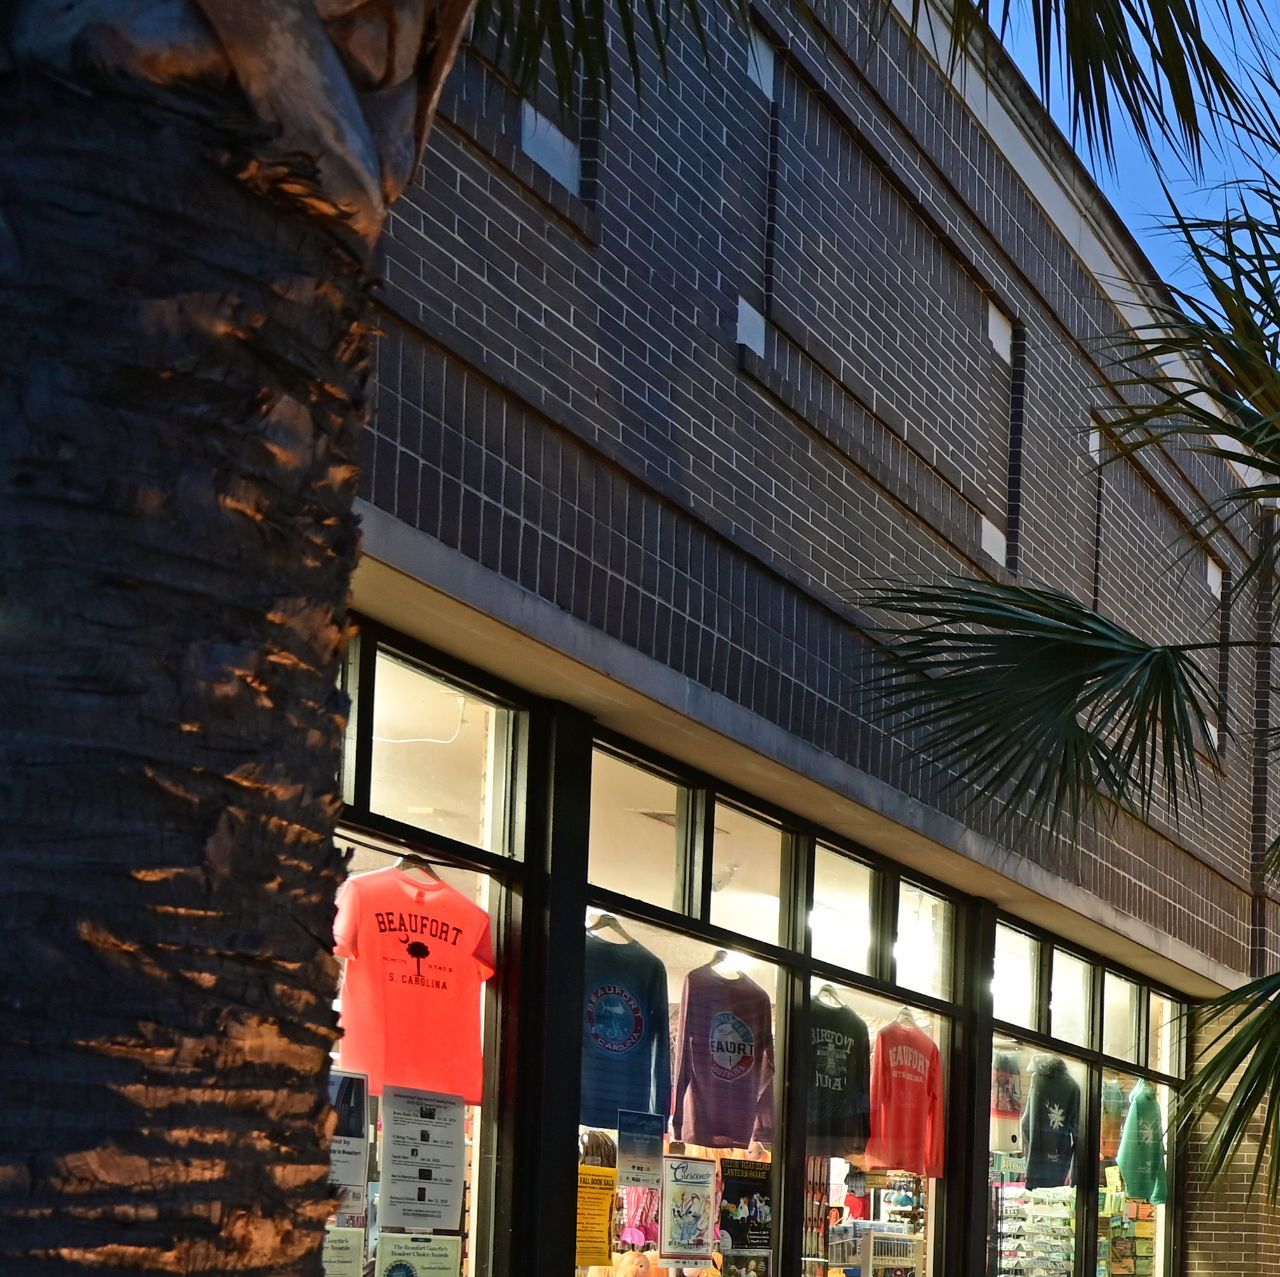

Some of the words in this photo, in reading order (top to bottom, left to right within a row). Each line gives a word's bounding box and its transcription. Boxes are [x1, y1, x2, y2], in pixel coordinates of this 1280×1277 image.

[375, 911, 463, 946] BEAUFORT
[401, 974, 448, 991] CAROLINA
[580, 1177, 590, 1185] FALL
[591, 1177, 602, 1186] BOOK
[603, 1178, 614, 1187] SALE
